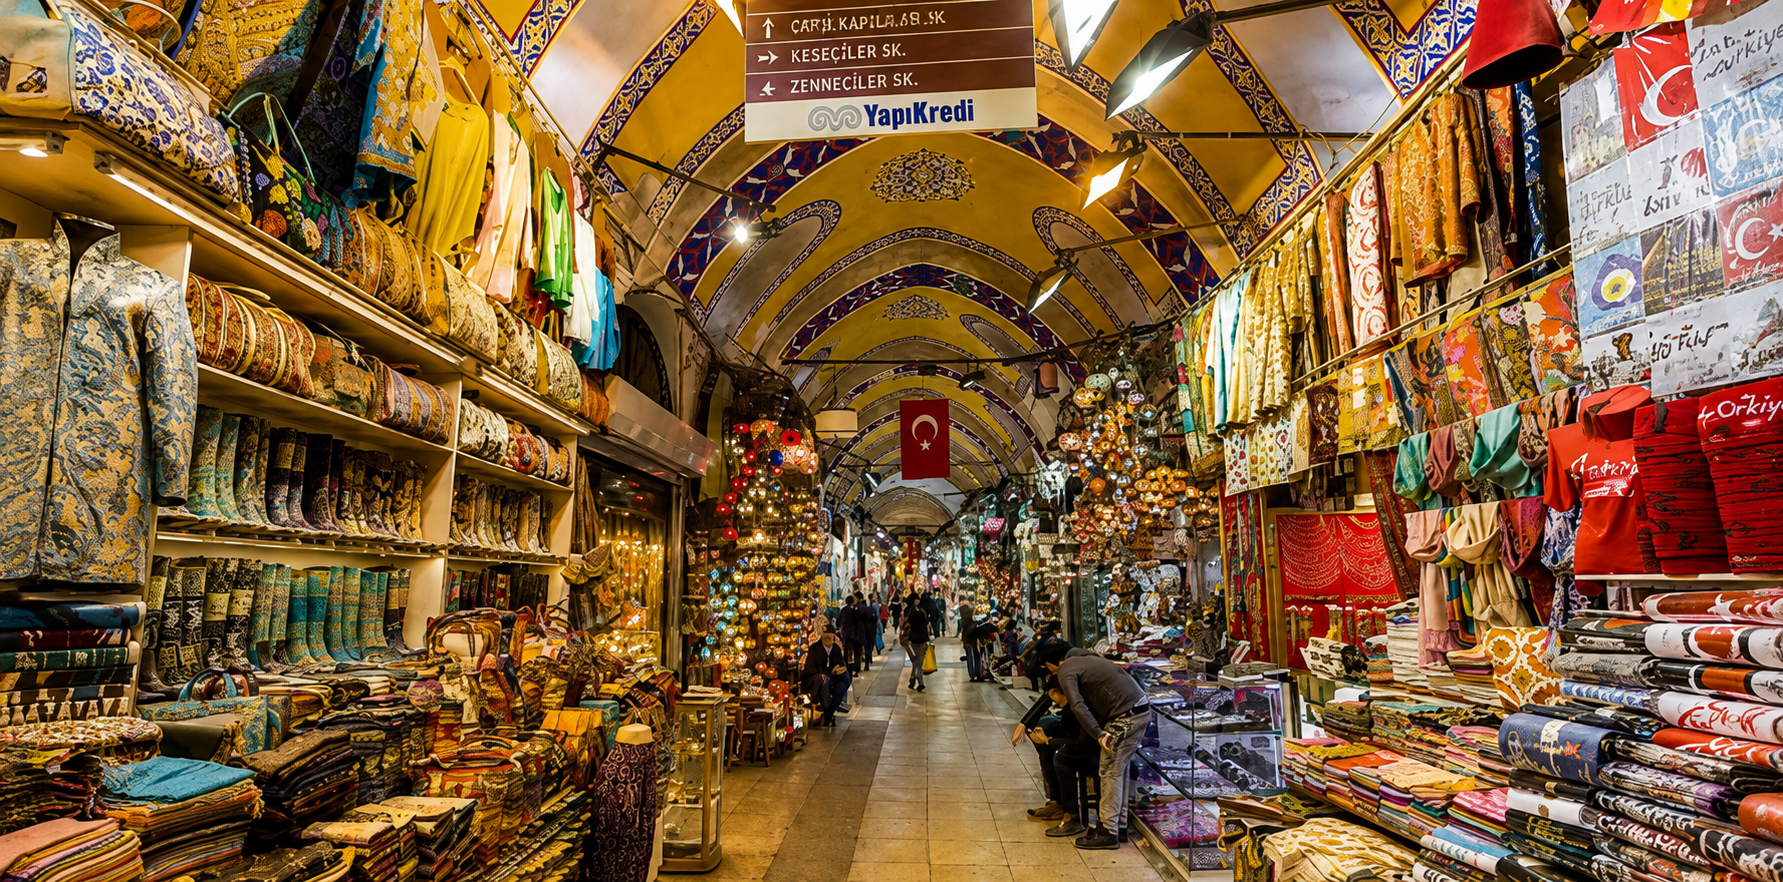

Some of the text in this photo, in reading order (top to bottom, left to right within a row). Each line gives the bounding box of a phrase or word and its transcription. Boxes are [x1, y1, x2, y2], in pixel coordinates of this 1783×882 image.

[791, 42, 907, 64] KESEÇİLER SK.
[893, 72, 919, 87] SK.
